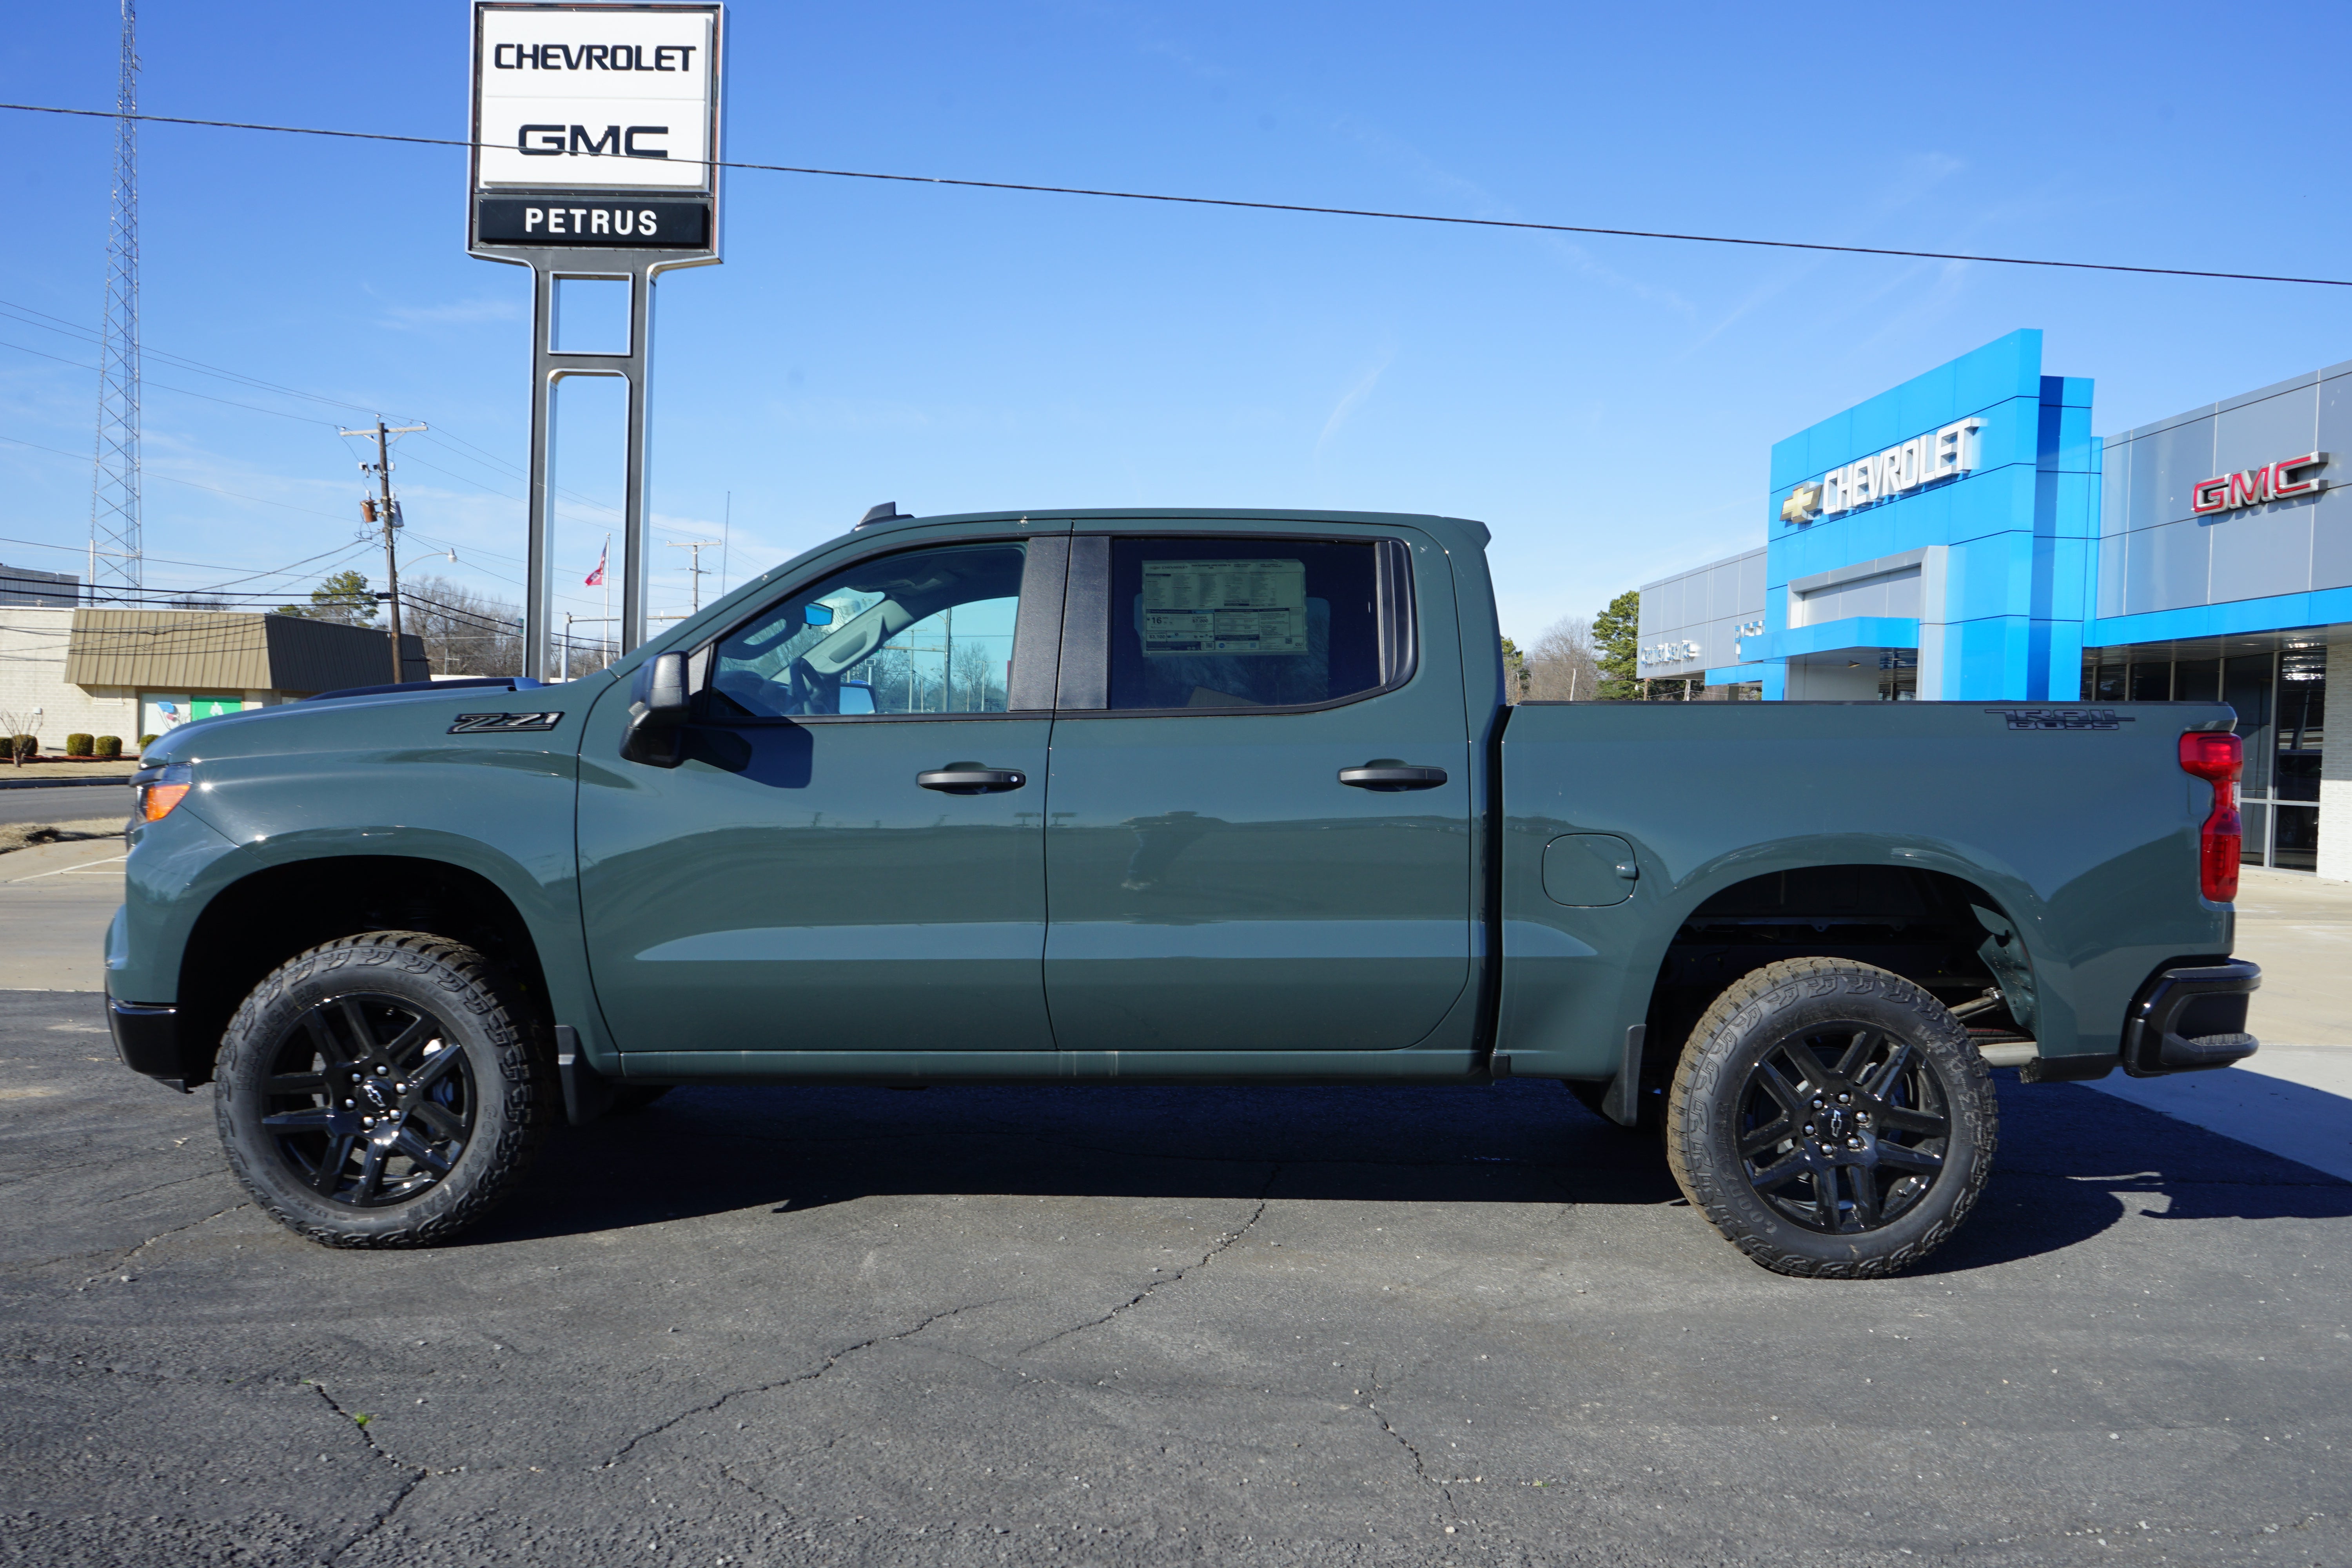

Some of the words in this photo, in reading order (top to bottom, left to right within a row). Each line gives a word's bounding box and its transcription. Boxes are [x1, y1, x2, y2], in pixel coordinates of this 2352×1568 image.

[494, 44, 697, 72] CHEVROLET
[518, 124, 668, 158] GMC
[525, 208, 657, 236] PETRUS
[1823, 417, 1985, 515] CHEVROLET
[2192, 451, 2329, 516] GMC
[446, 711, 566, 734] Z71
[1985, 709, 2136, 722] TRAIL
[2007, 720, 2119, 730] BOSS
[408, 1104, 498, 1222] GOODYEAR
[1714, 1101, 1778, 1235] GOODYEAR
